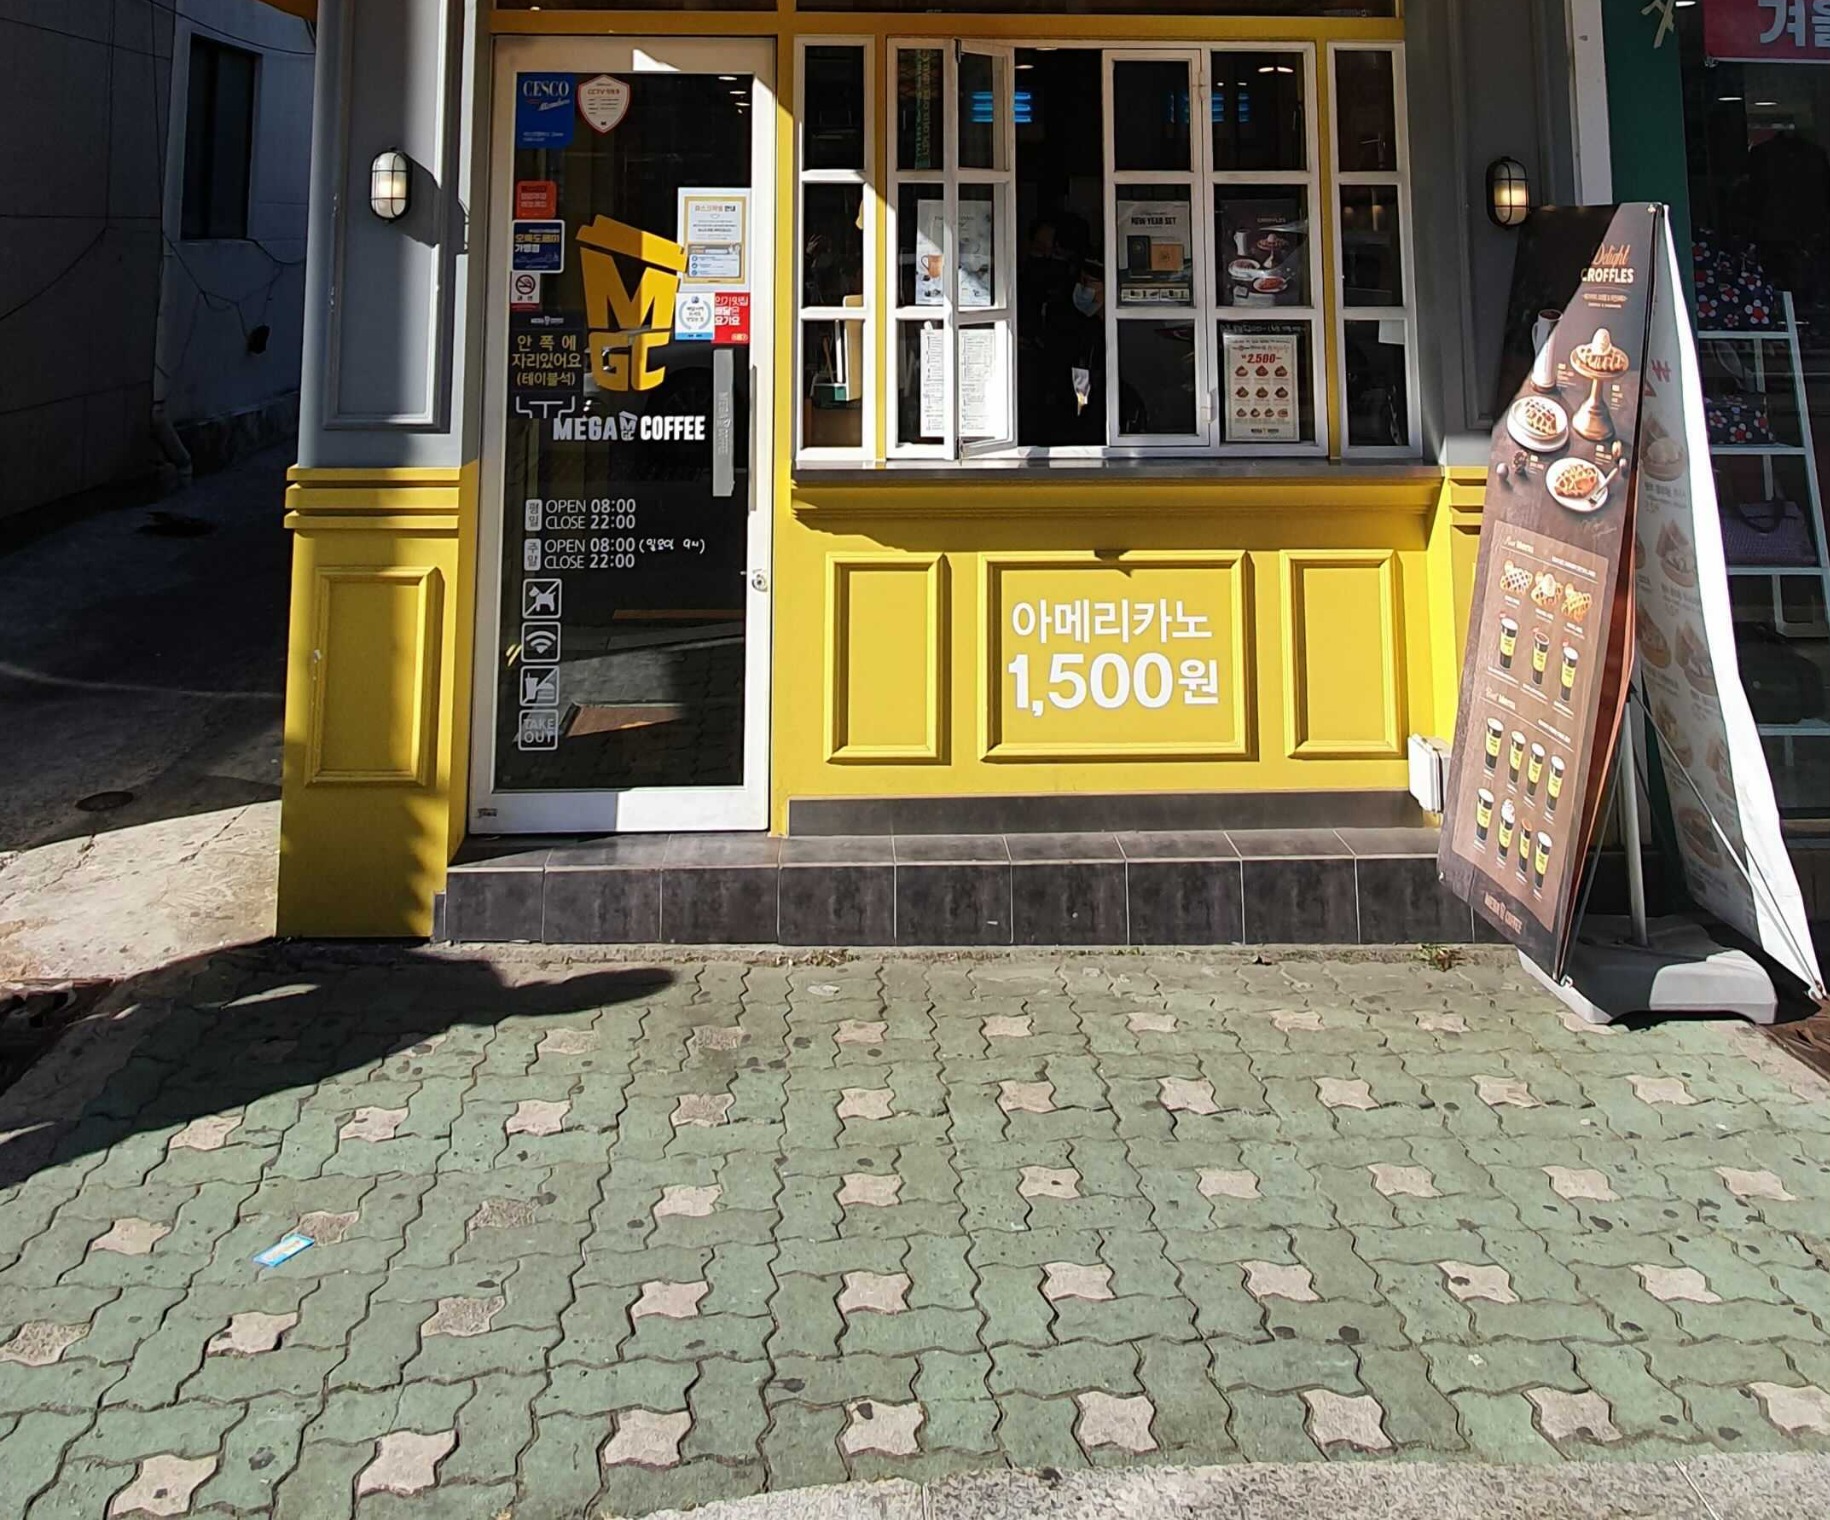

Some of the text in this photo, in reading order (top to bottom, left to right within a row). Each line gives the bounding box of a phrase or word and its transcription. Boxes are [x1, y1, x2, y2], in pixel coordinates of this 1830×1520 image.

[523, 80, 570, 97] CESCO
[1581, 267, 1635, 284] CROFFLES
[715, 316, 741, 326] 요기요
[512, 352, 582, 369] 자리있어요
[553, 415, 706, 441] MEGA COFFEE
[545, 498, 637, 513] OPEN 08:00
[545, 514, 636, 530] CLOSE 22:00
[544, 537, 636, 553] OPEN 08:00
[526, 542, 539, 567] 주말
[544, 553, 636, 569] CLOSE 22:00
[1011, 598, 1213, 644] 아메리카노
[1007, 652, 1219, 717] 1,500원
[523, 718, 555, 730] TAKE
[523, 730, 554, 743] OUT
